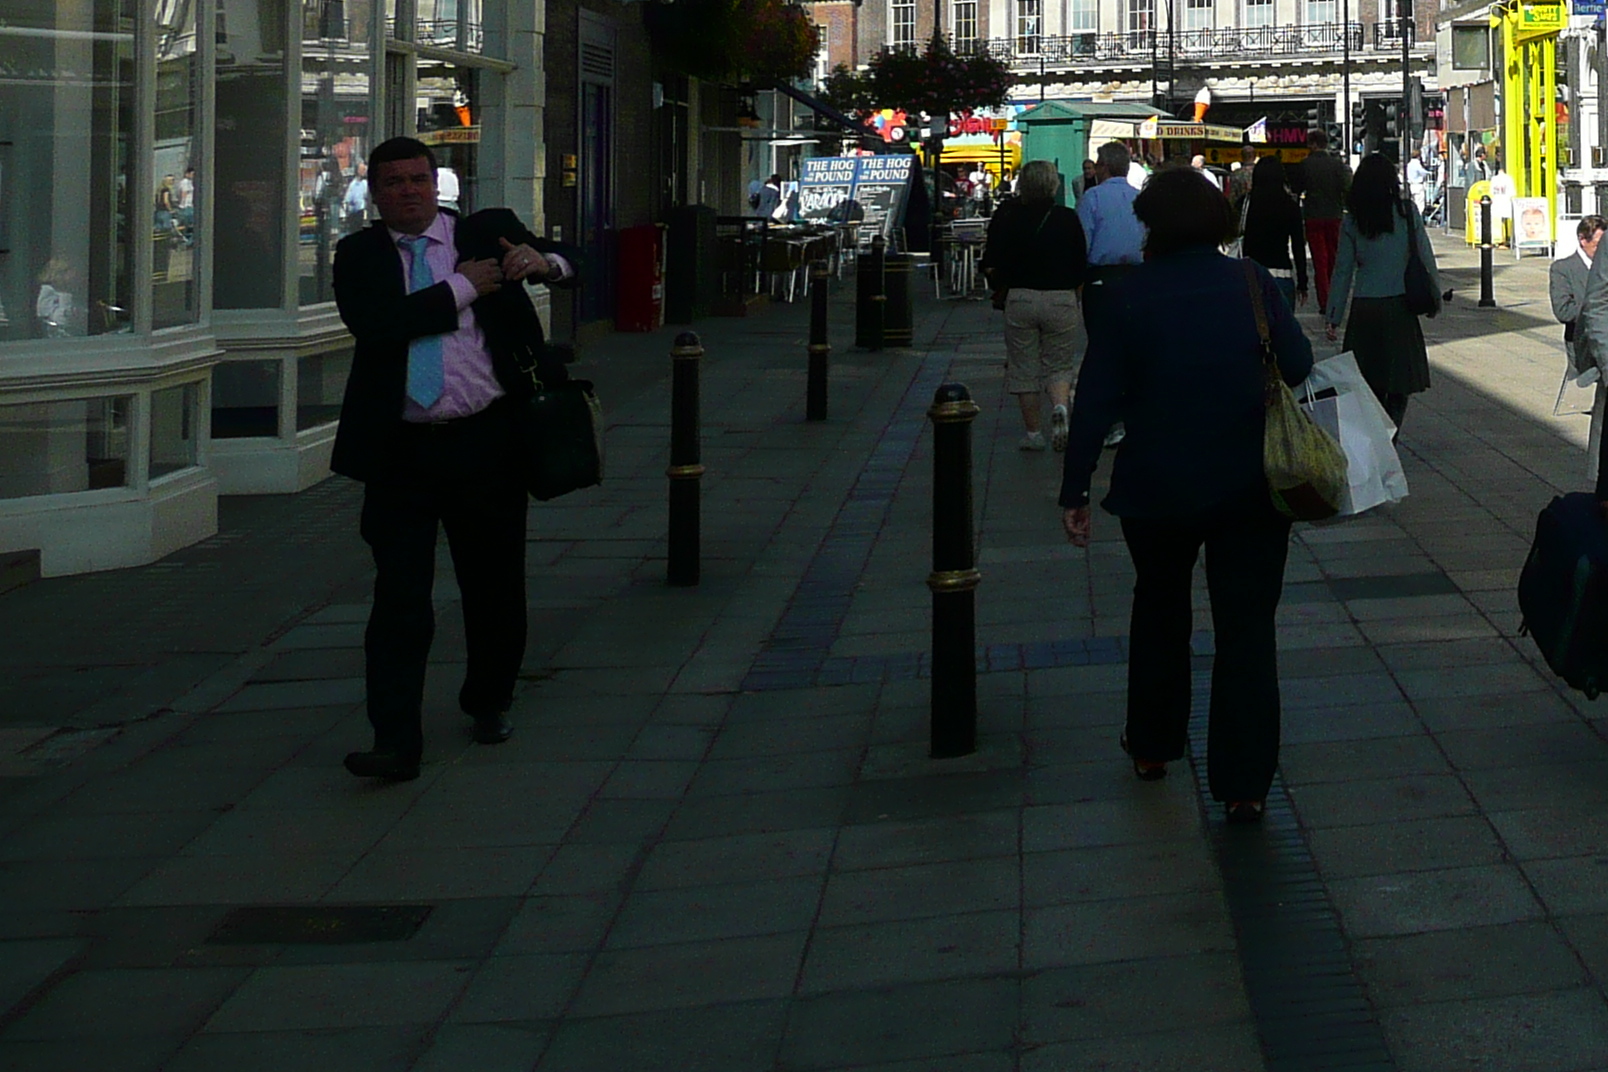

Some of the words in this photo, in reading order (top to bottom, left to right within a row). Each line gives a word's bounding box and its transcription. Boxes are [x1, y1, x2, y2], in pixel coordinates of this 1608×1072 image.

[1166, 126, 1204, 136] DRINKS
[1274, 128, 1307, 143] HMV
[806, 160, 828, 171] THE
[830, 160, 854, 170] HOG
[862, 158, 884, 169] THE
[886, 158, 912, 168] HOG
[814, 171, 852, 182] POUND
[870, 169, 909, 180] POUND
